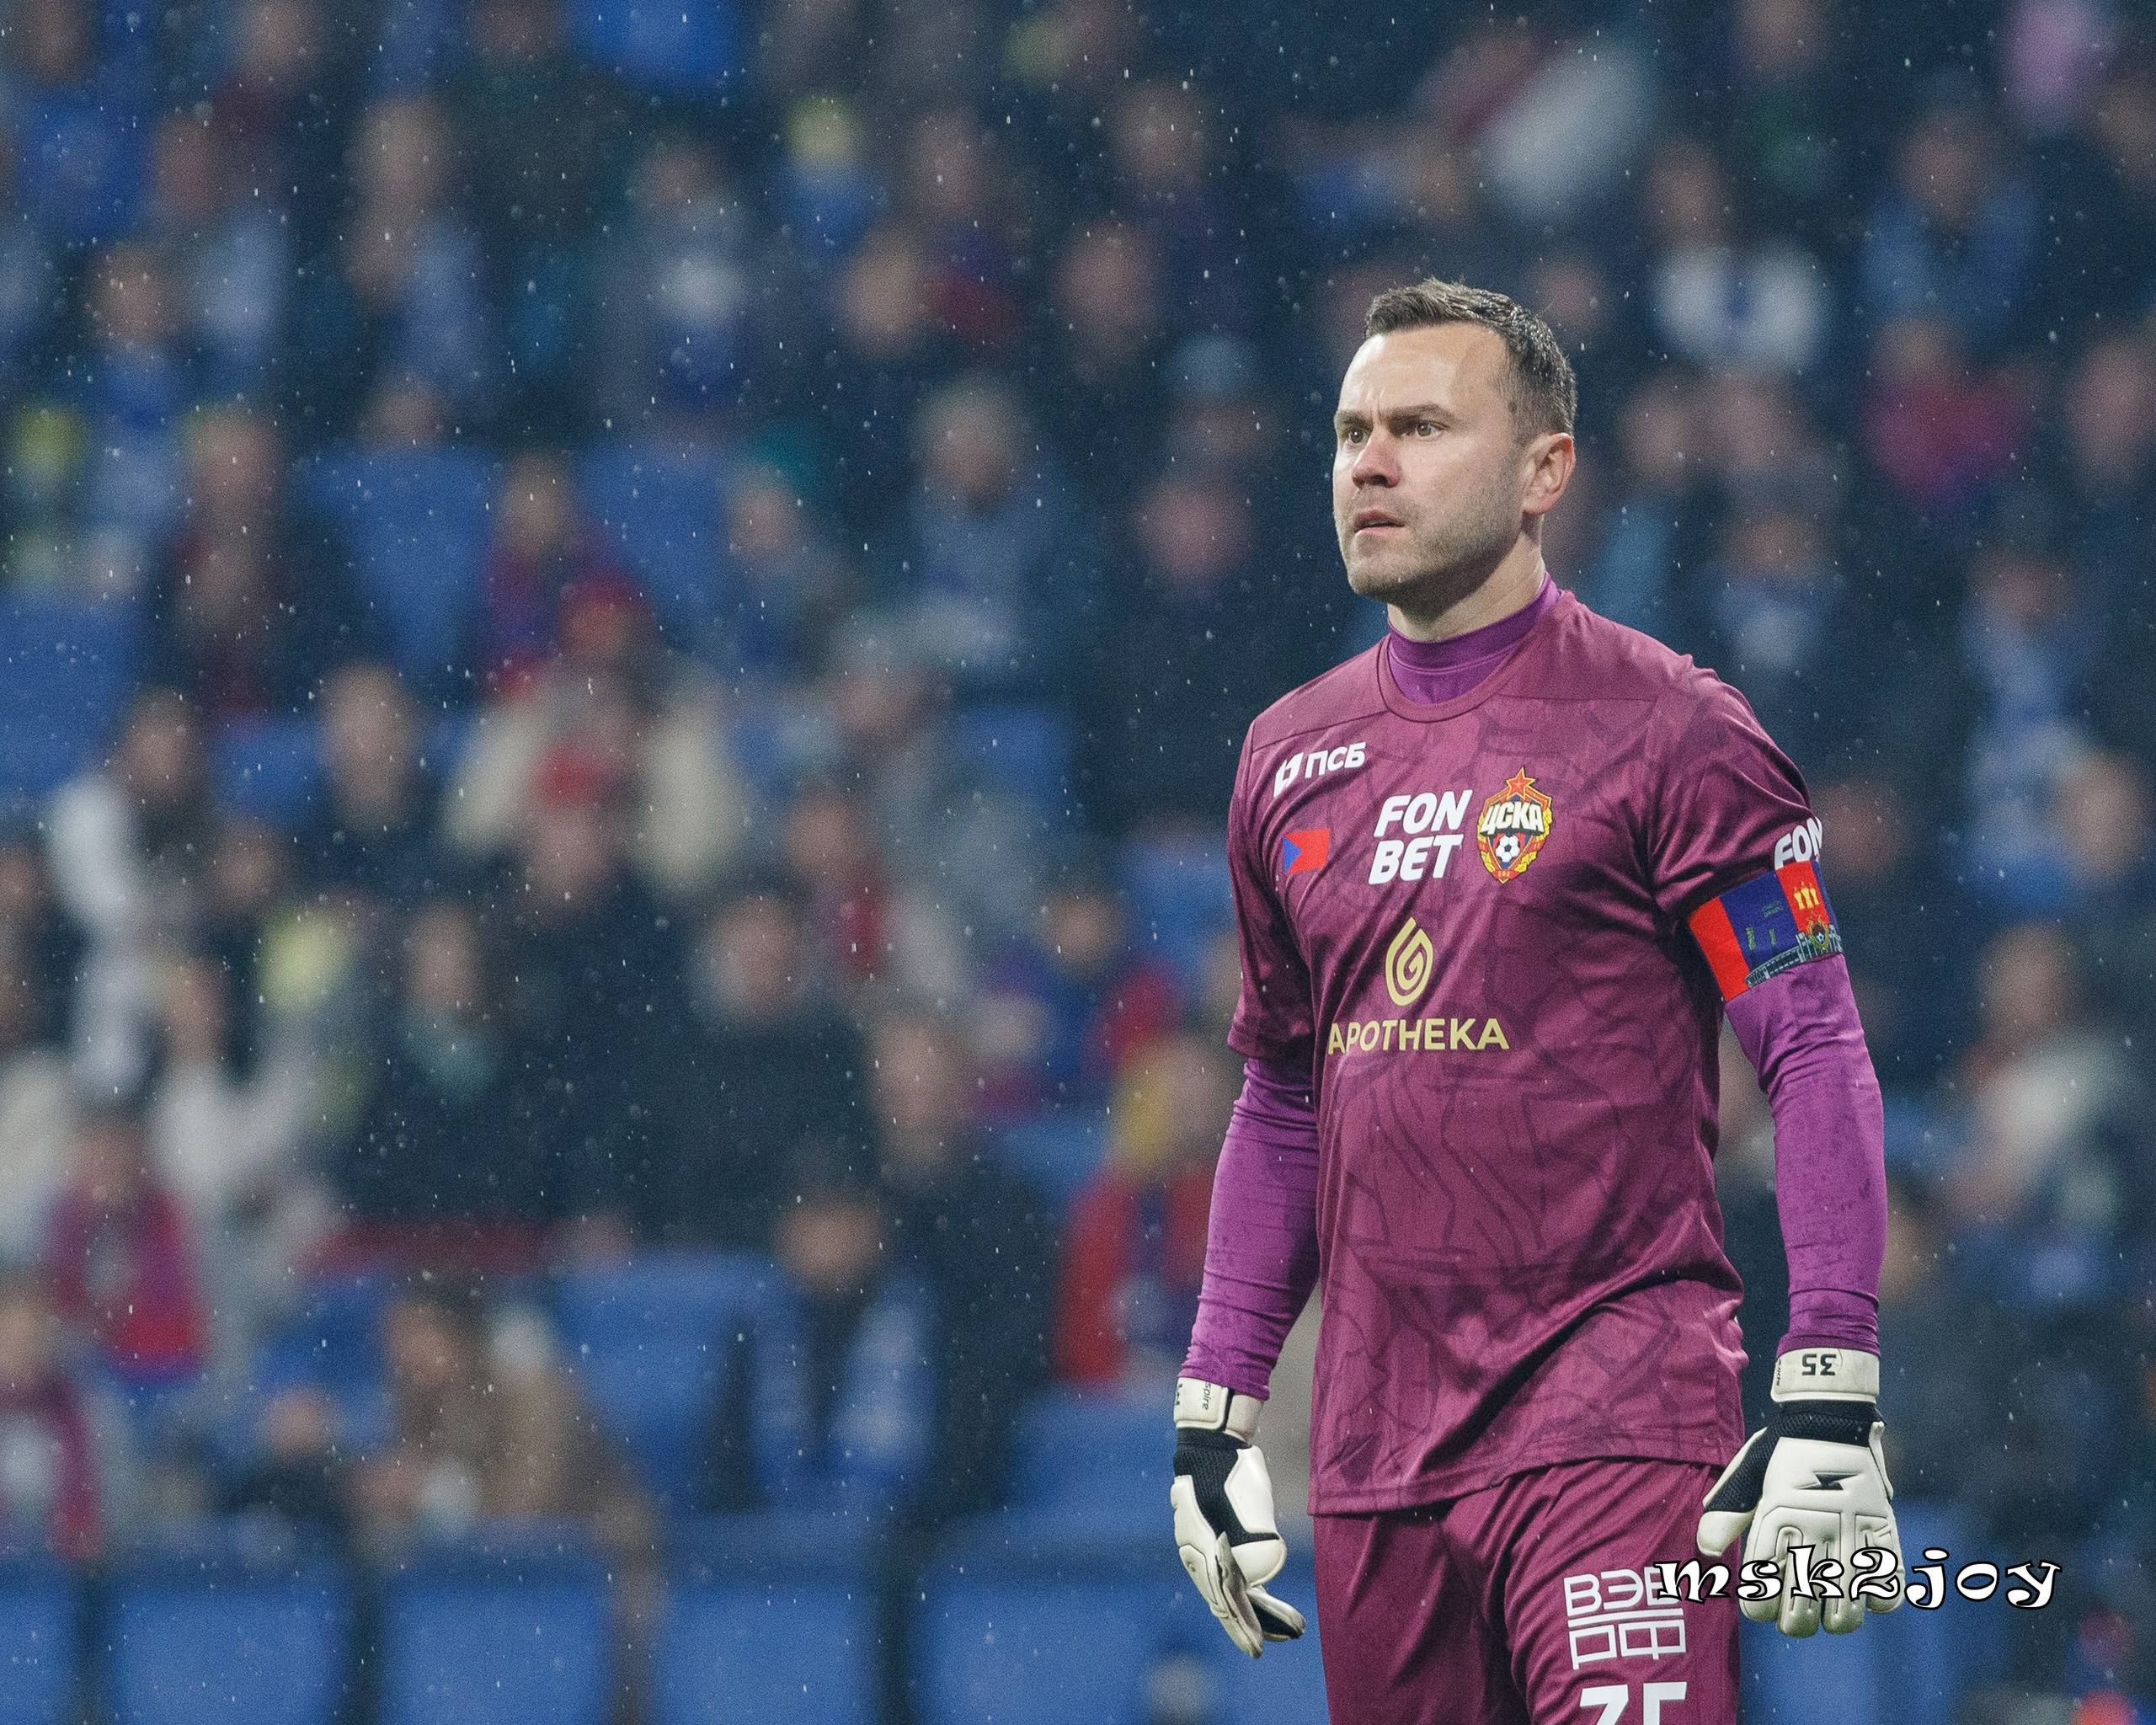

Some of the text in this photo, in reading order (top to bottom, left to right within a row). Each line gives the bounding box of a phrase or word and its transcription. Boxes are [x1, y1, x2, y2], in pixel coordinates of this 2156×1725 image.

[1305, 741, 1366, 779] ПСБ
[1373, 789, 1473, 837] FON
[1480, 800, 1545, 836] ЦСКА
[1368, 833, 1464, 885] BET
[1774, 815, 1822, 870] FON
[1328, 1017, 1510, 1055] APOTHEKA
[1801, 1353, 1837, 1376] 35
